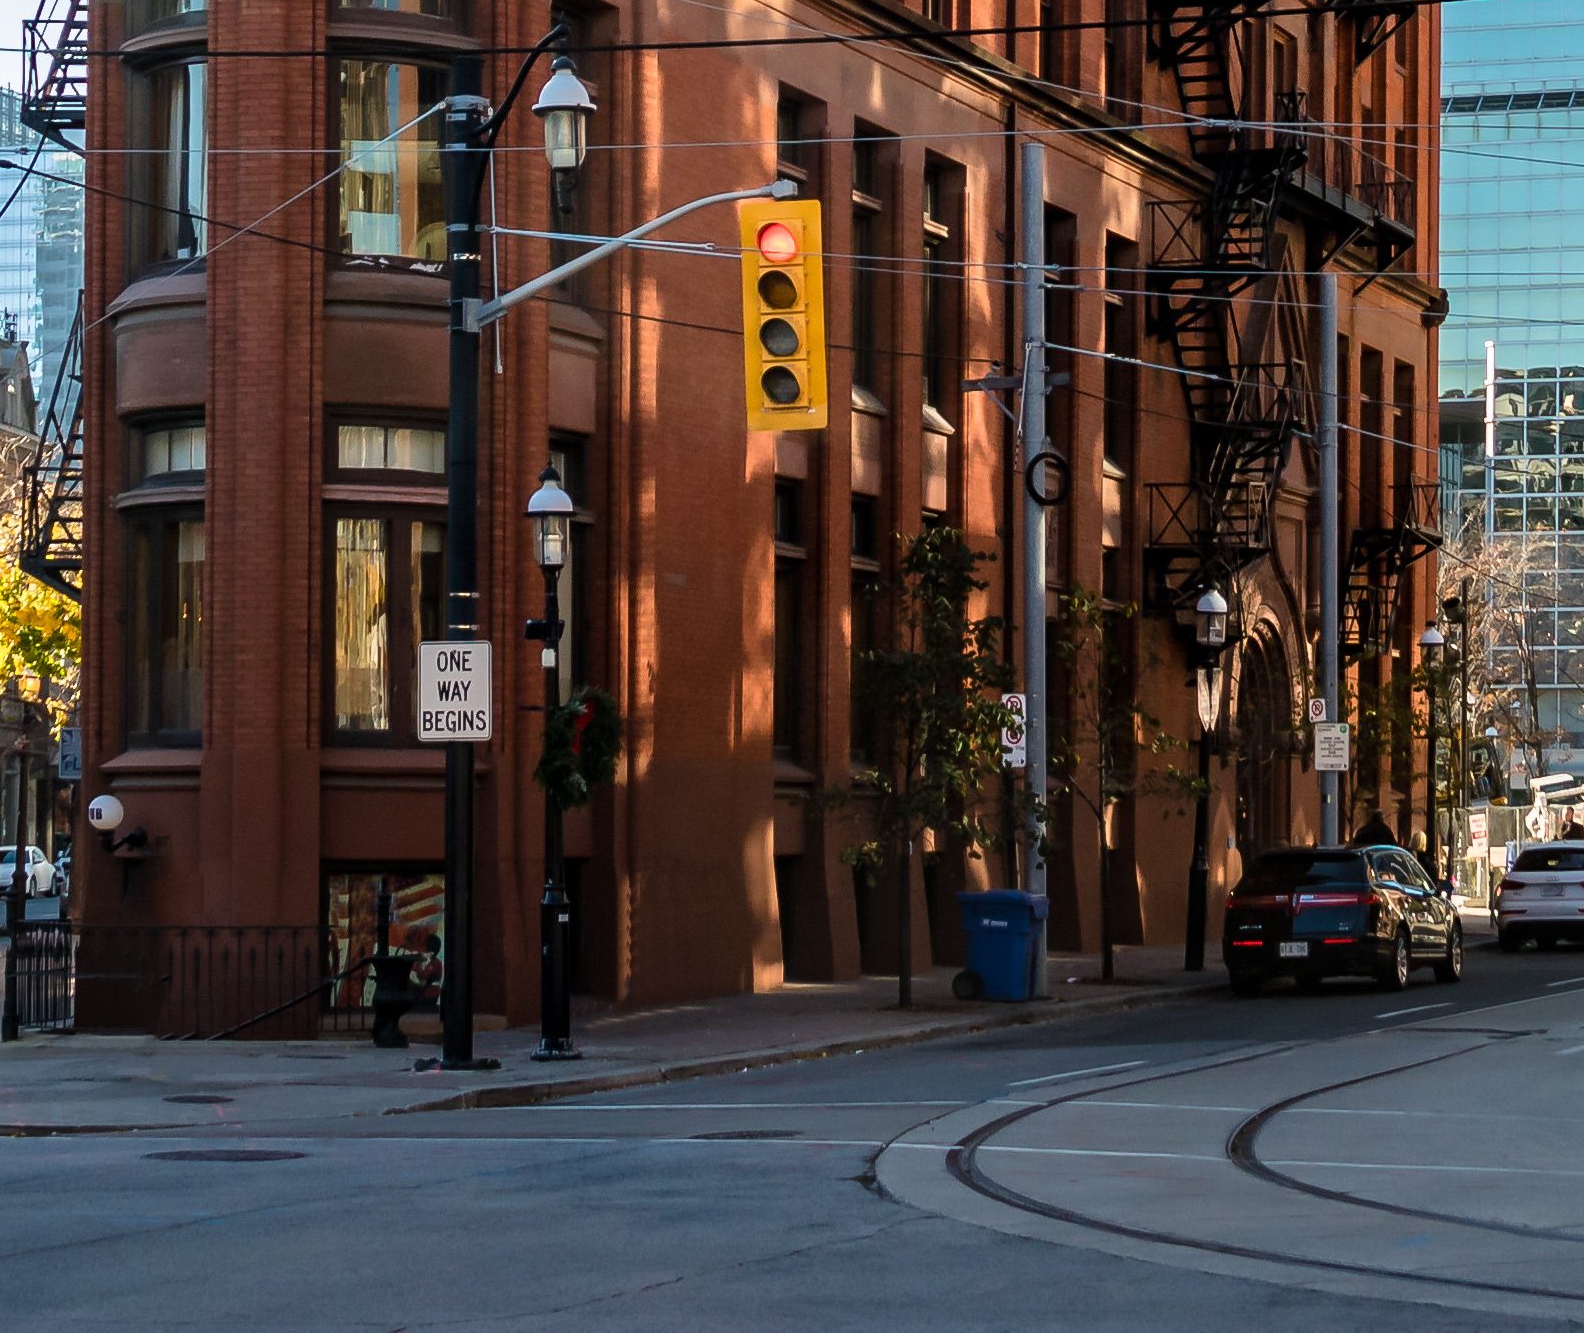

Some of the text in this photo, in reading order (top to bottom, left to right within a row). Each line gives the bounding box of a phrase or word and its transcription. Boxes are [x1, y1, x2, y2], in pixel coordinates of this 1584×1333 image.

[436, 650, 472, 672] ONE
[437, 680, 472, 702] WAY
[422, 710, 487, 732] BEGINS
